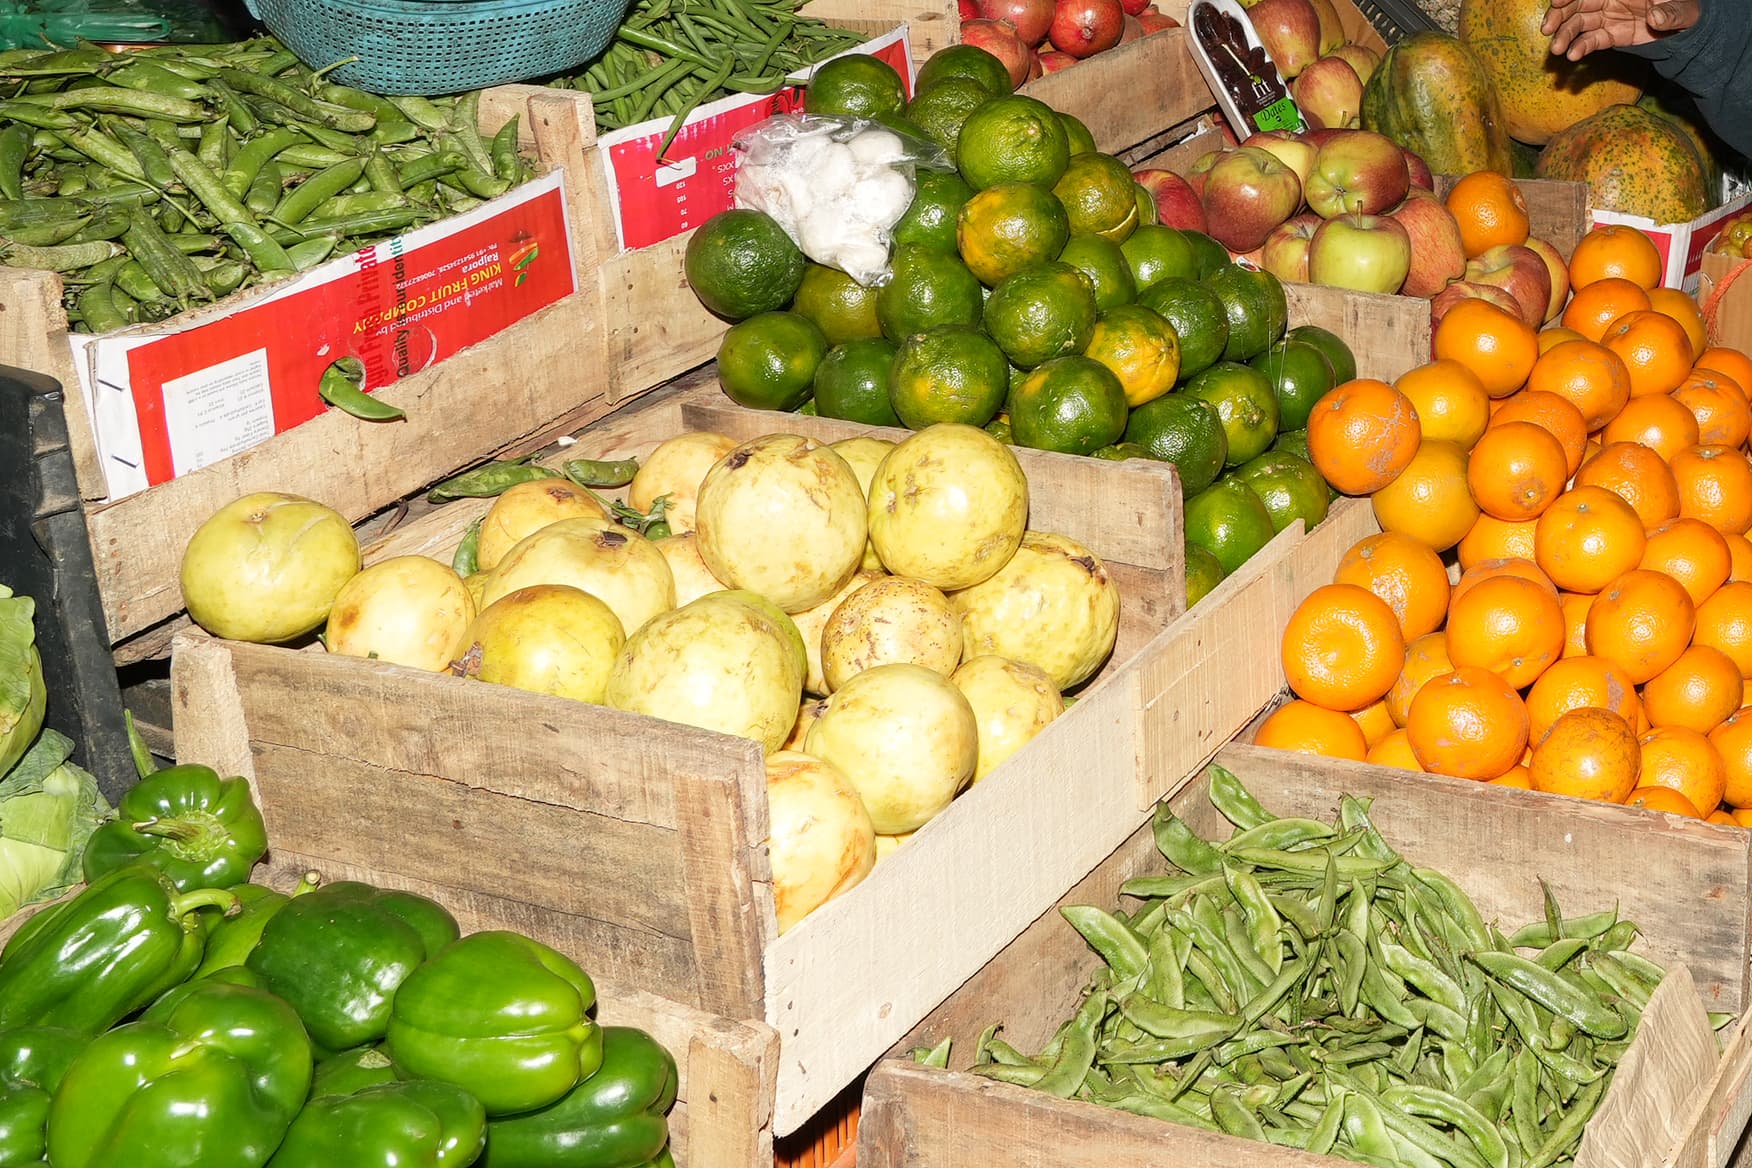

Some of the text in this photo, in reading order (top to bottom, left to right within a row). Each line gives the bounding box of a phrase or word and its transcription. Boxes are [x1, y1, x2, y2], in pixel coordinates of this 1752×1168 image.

[1261, 102, 1287, 122] Dates
[462, 251, 499, 273] Rajpora
[470, 262, 502, 286] KING
[429, 277, 469, 304] FRUIT
[444, 295, 463, 311] and
[393, 329, 411, 379] Quality
